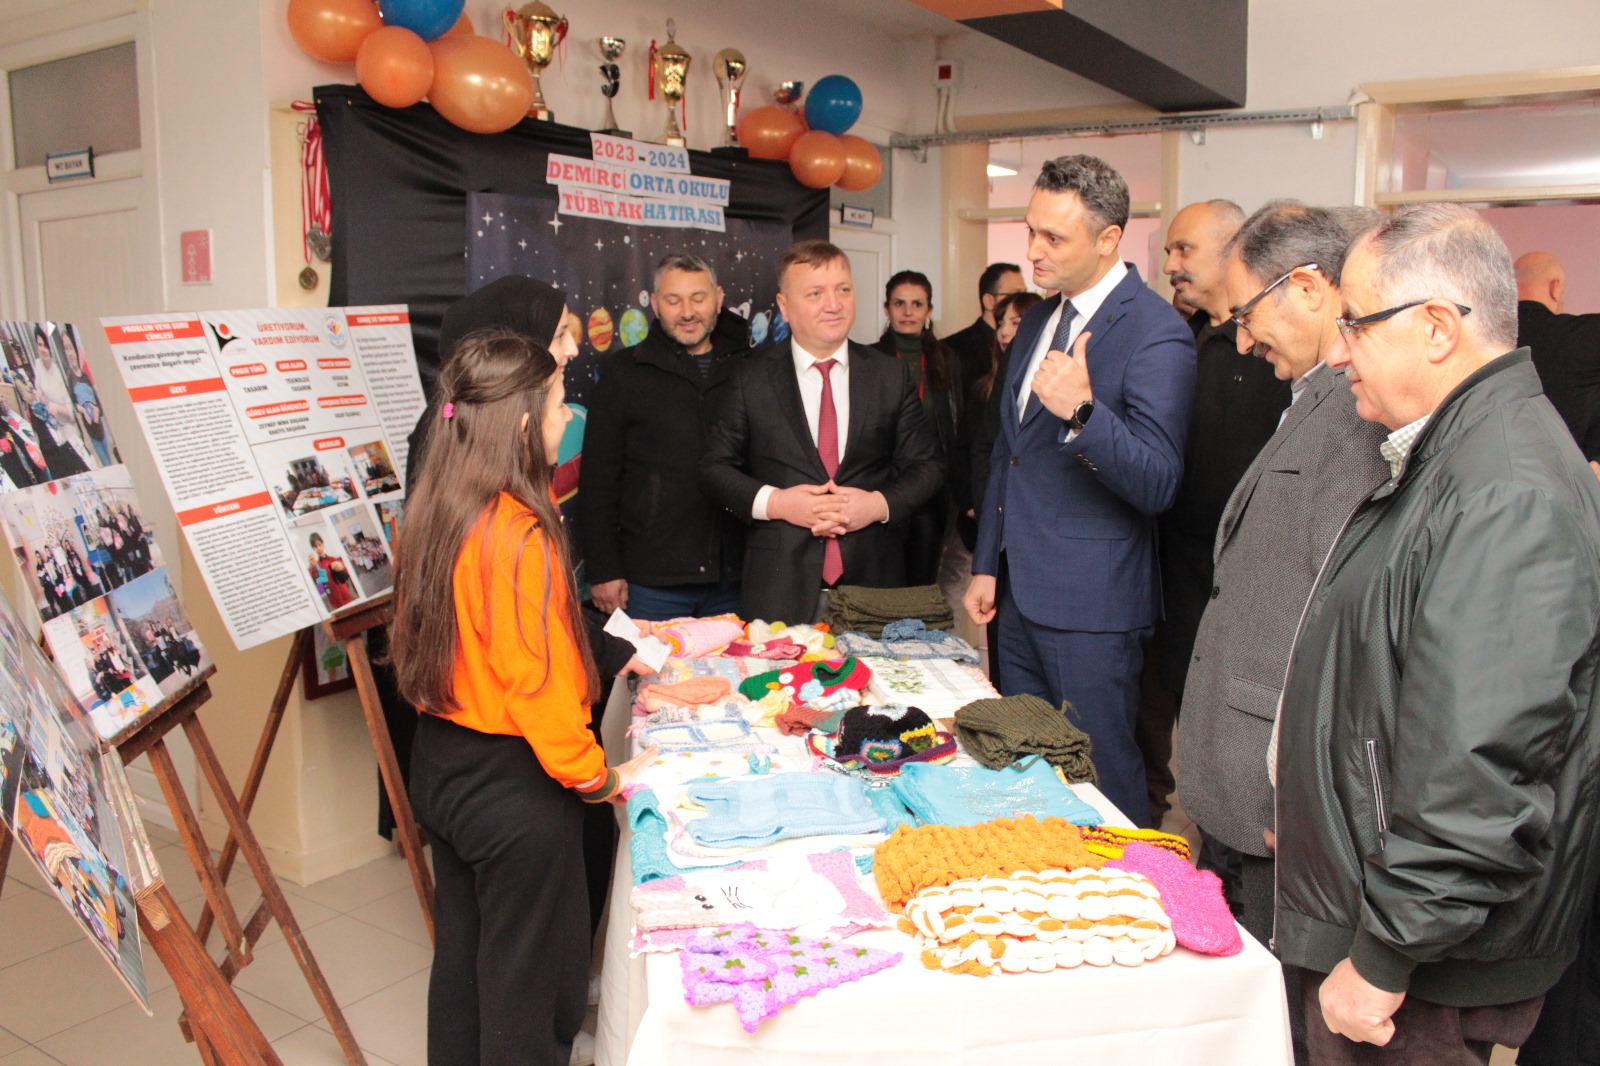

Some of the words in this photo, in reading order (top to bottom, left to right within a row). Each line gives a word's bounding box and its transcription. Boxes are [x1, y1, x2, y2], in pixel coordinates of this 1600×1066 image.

[548, 161, 627, 191] DEMİRCİ
[630, 173, 675, 194] ORTA
[678, 179, 728, 200] OKULU
[562, 190, 642, 220] TÜBİTAK
[644, 202, 721, 226] HATIRASI
[122, 323, 154, 333] PROBLEM
[252, 336, 283, 346] YARDIM
[169, 384, 187, 394] ÖZET
[243, 384, 268, 393] TASARIM
